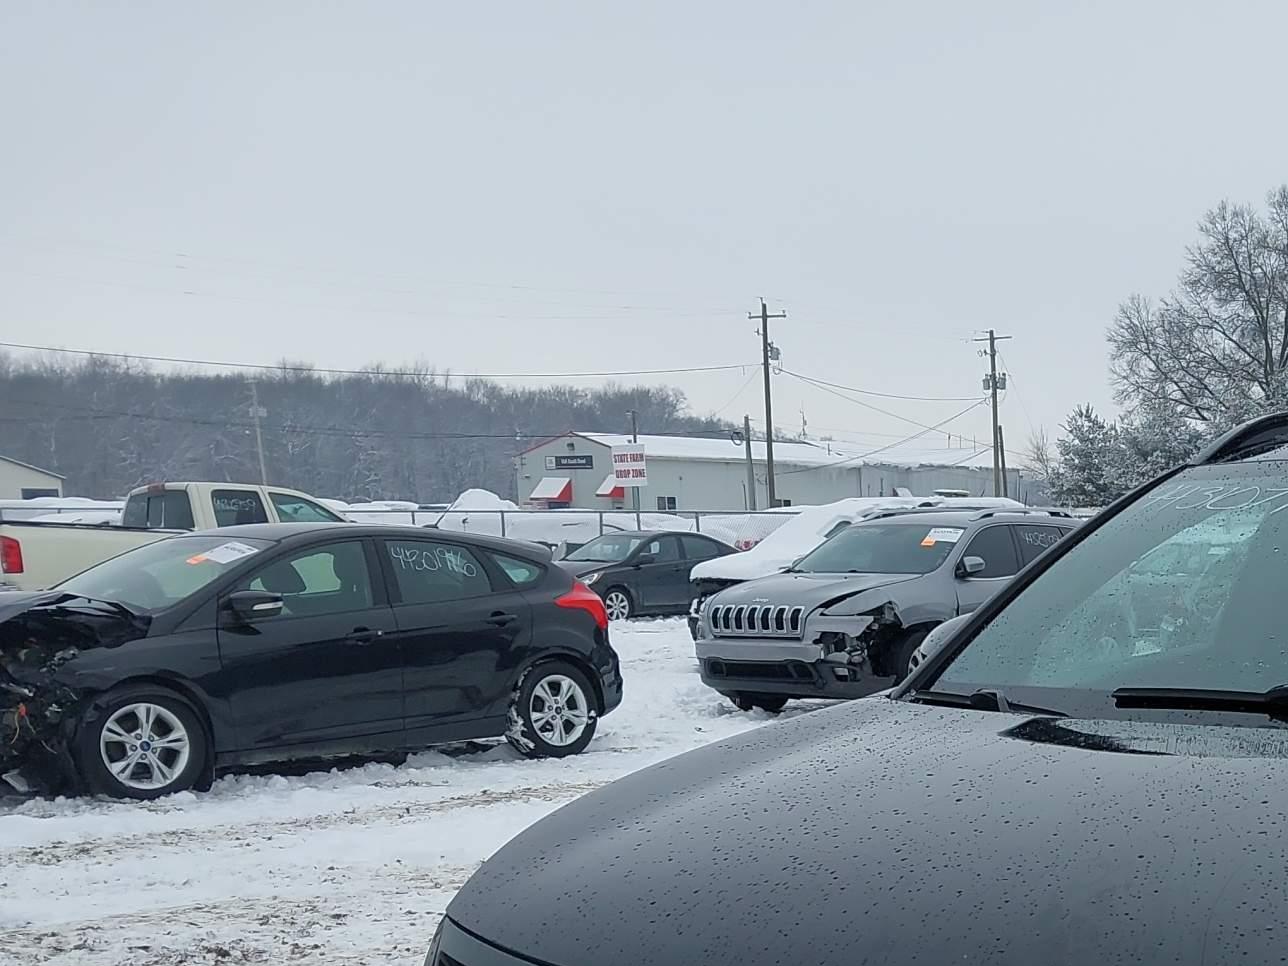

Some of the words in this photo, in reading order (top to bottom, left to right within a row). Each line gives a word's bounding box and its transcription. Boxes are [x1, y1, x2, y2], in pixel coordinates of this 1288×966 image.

[613, 453, 630, 464] STATE
[630, 452, 644, 463] FARM
[615, 469, 631, 479] DROP
[631, 468, 646, 478] ZONE
